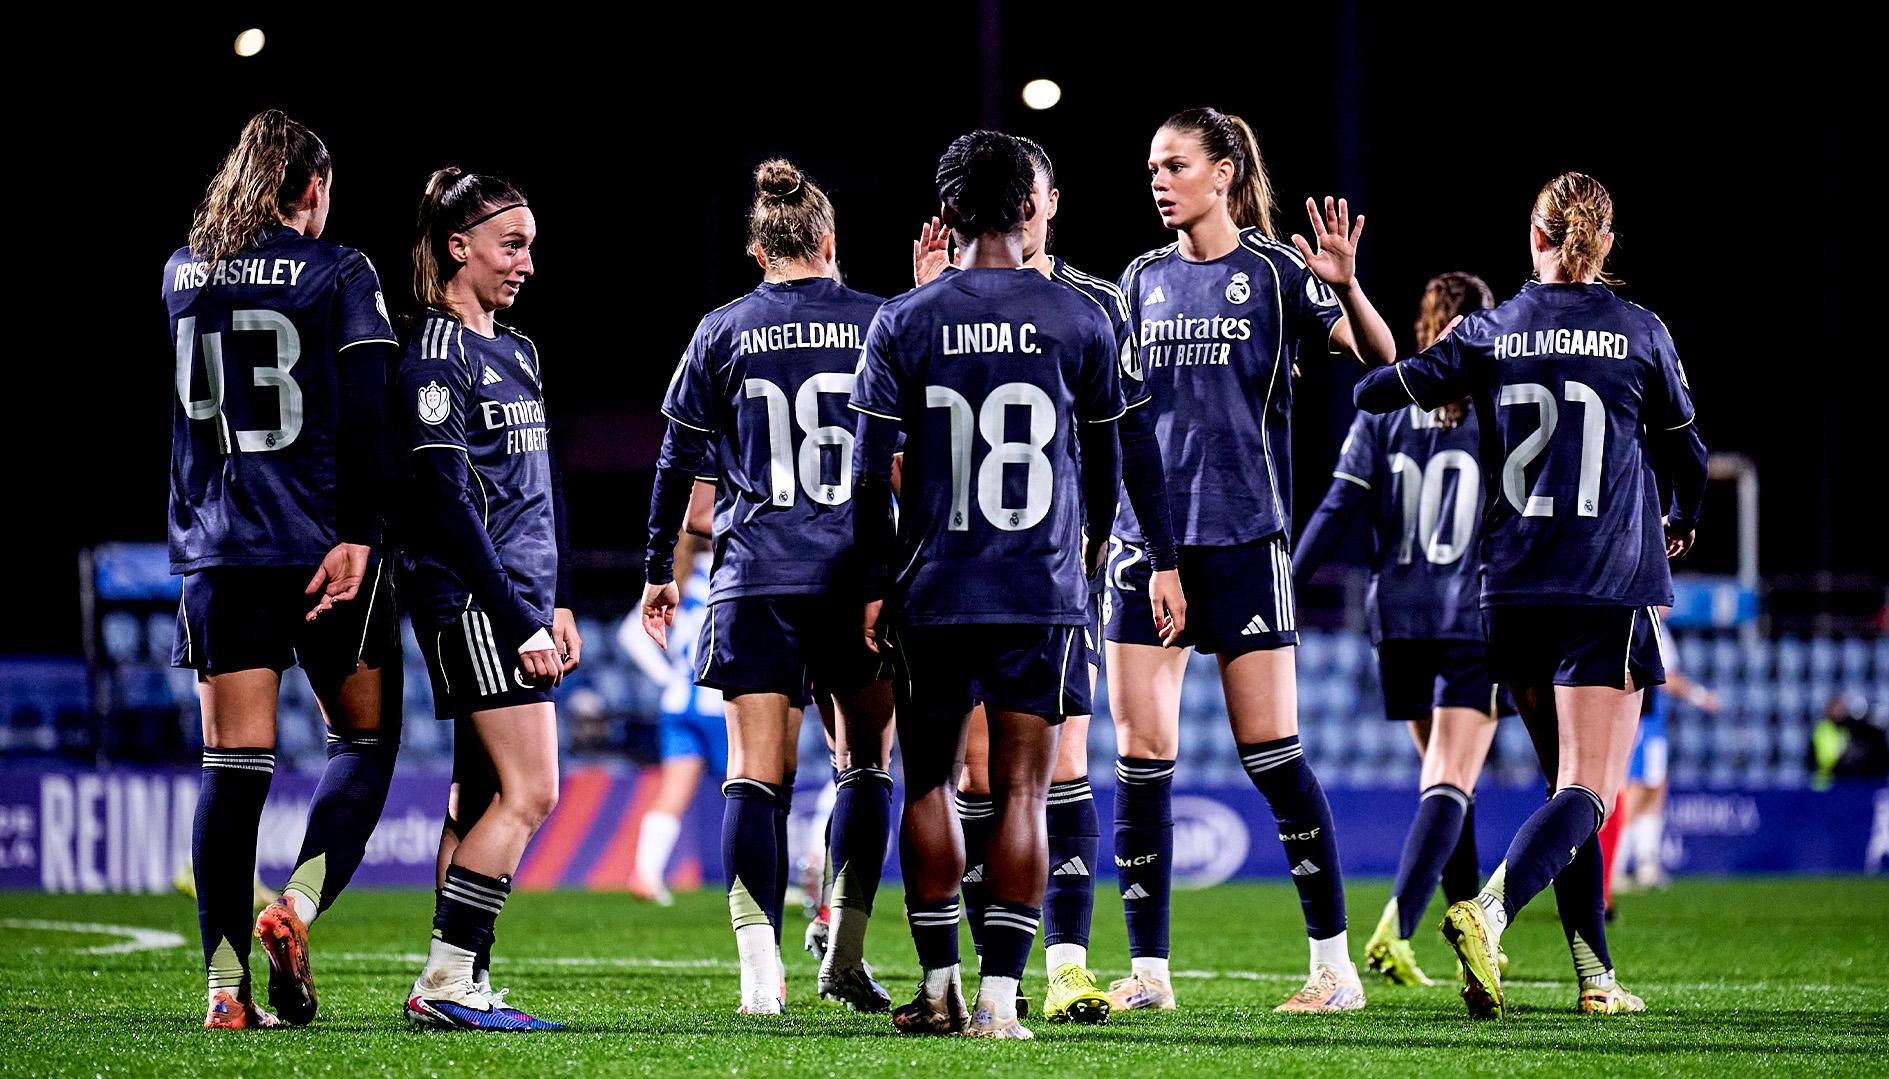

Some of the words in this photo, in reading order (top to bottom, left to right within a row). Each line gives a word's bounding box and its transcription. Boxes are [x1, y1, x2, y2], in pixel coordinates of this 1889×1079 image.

[173, 261, 209, 292] IRIS
[212, 258, 307, 287] ASHLEY
[739, 322, 865, 356] ANGELDAHL
[942, 323, 1013, 355] LINDA
[1019, 323, 1043, 354] C.
[1140, 312, 1252, 348] Emirates
[1494, 328, 1629, 361] HOLMGAARD
[1148, 344, 1172, 369] FLY
[1175, 342, 1231, 367] BETTER
[176, 309, 304, 454] 43
[480, 394, 546, 430] Emira
[745, 372, 856, 507] 16
[925, 382, 1057, 532] 18
[1499, 380, 1606, 518] 21
[1387, 449, 1480, 565] 10
